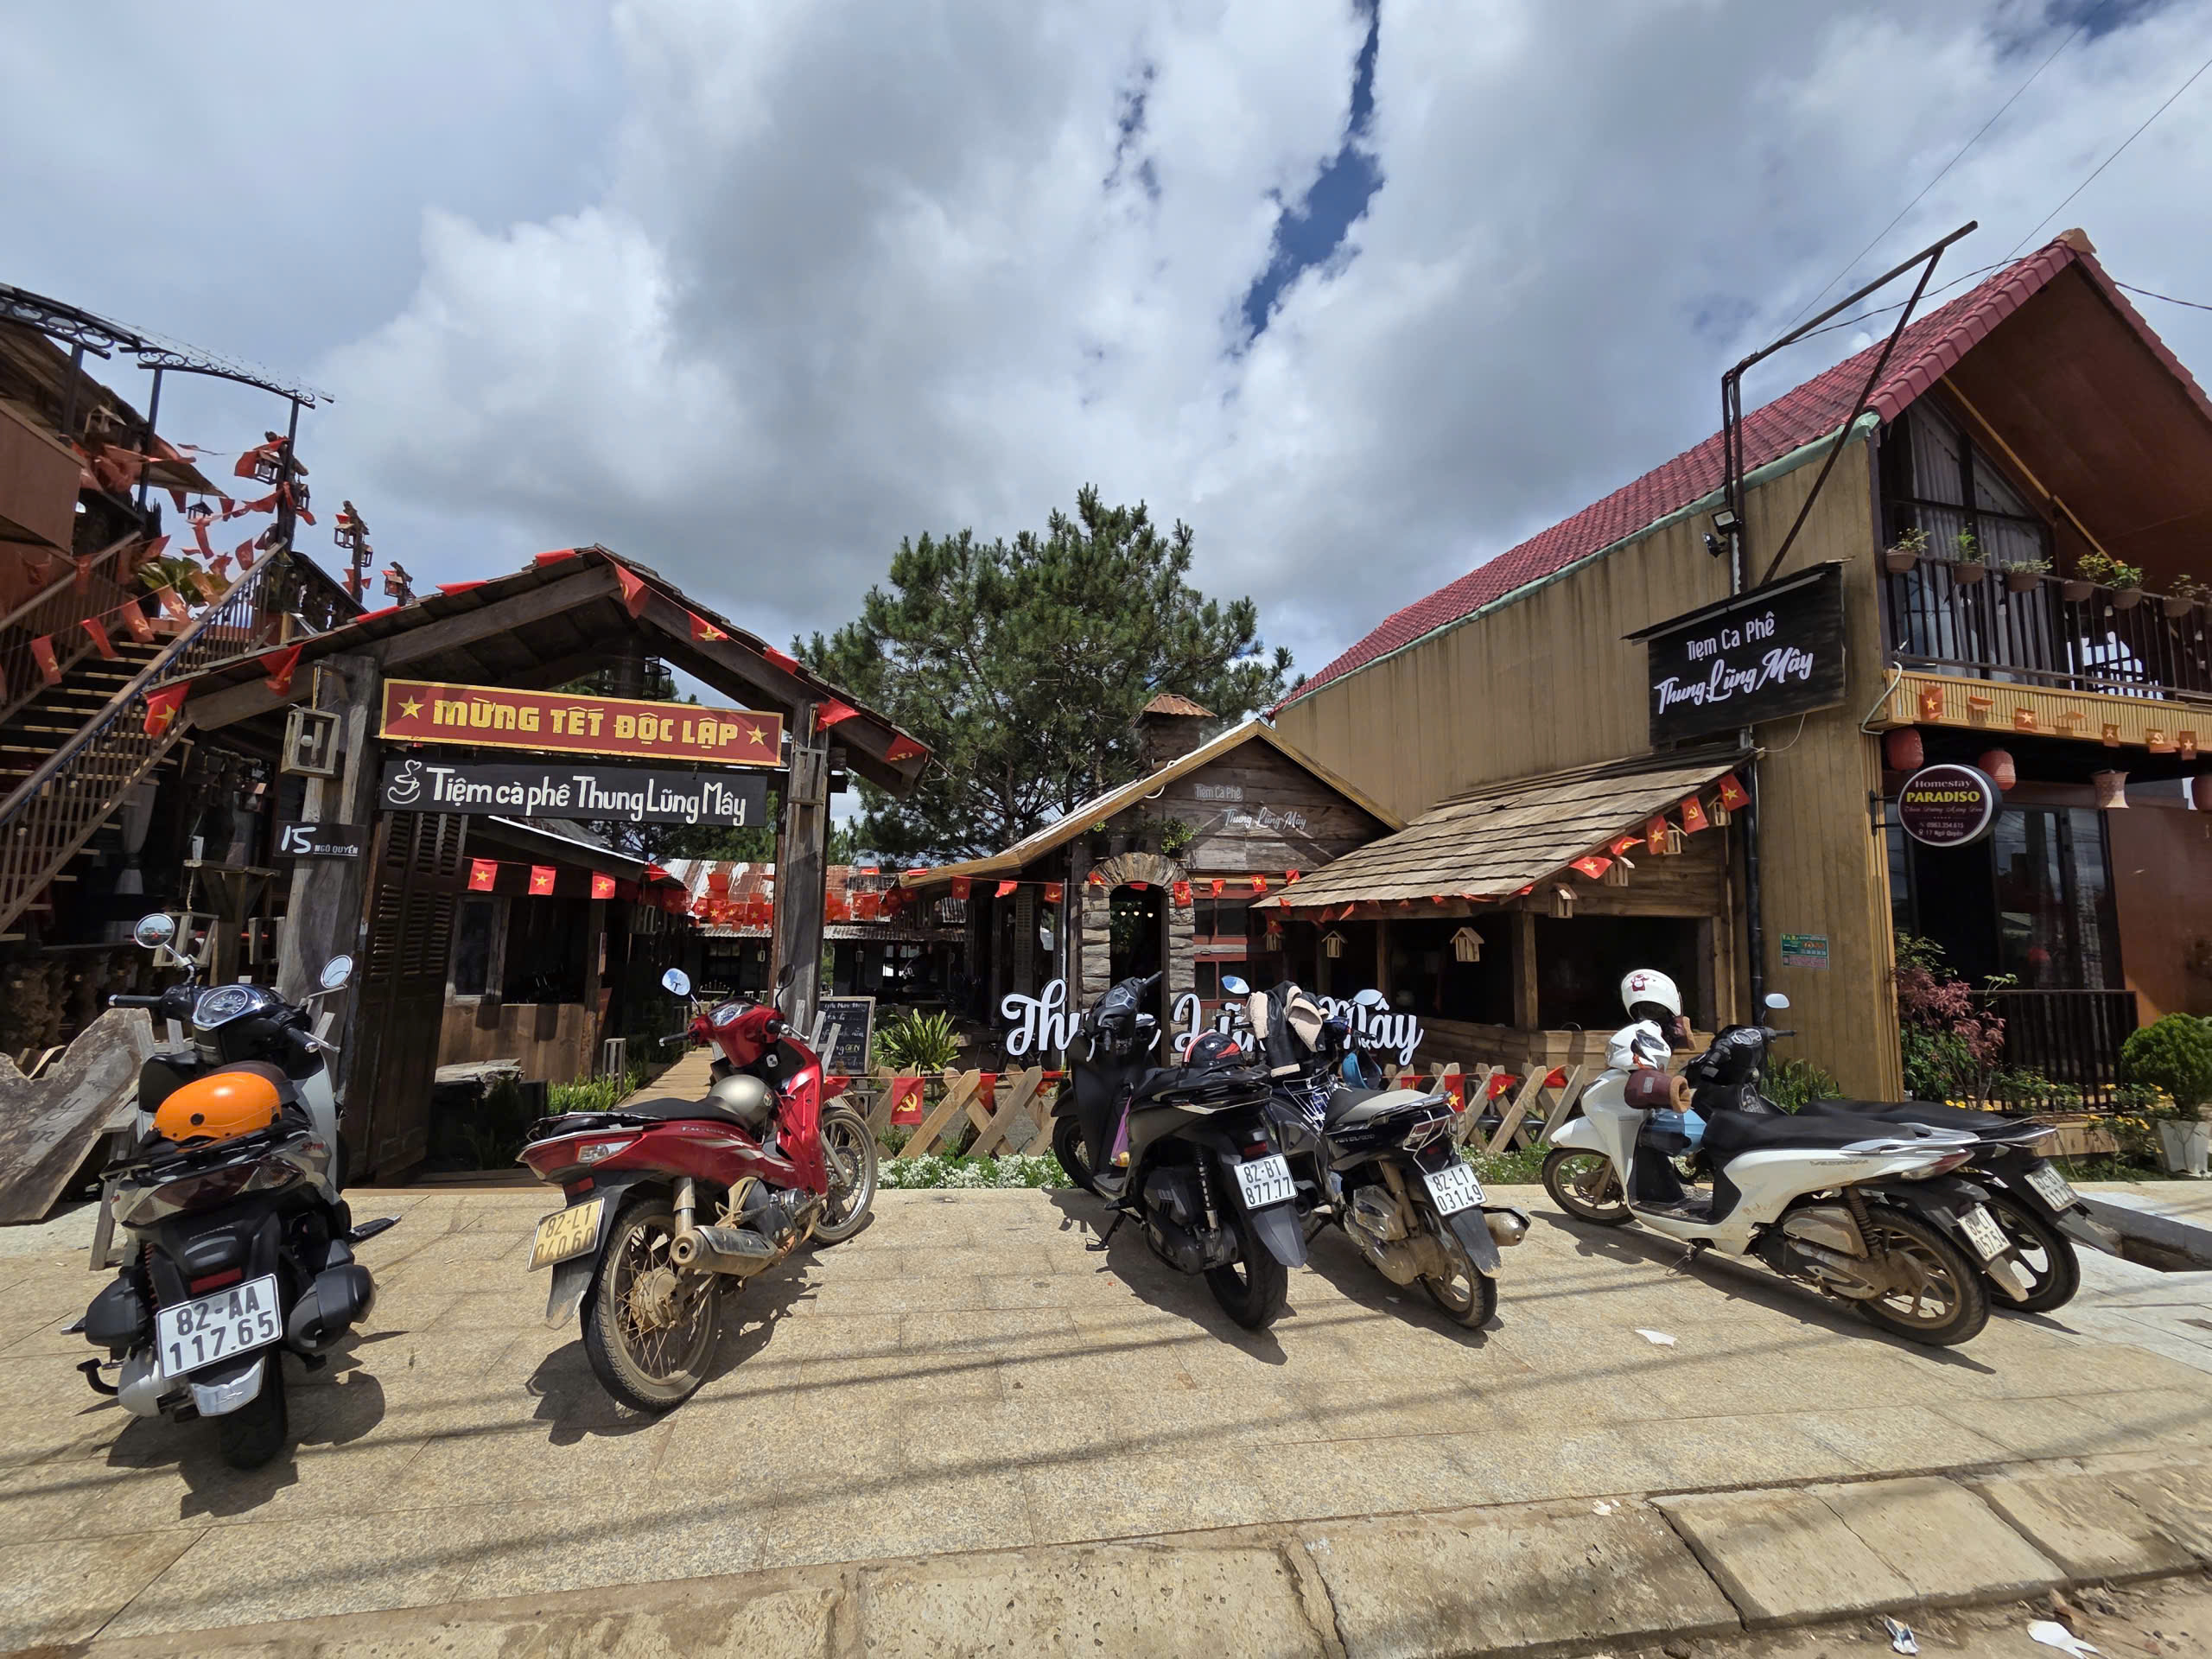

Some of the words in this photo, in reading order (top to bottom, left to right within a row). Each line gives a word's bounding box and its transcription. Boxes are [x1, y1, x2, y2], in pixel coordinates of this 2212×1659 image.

[1745, 610, 1775, 643] Phê
[1654, 677, 1706, 715] Thung
[1706, 659, 1757, 702] Lũng
[1756, 647, 1814, 690] Mây
[433, 697, 539, 732] MỪNG
[550, 706, 604, 736] TẾT
[613, 712, 674, 745] ĐỘC
[682, 717, 739, 749] LẬP
[426, 766, 493, 807] Tiệm
[495, 781, 524, 804] cà
[525, 776, 571, 817] phê
[573, 775, 644, 822] Thung
[647, 779, 699, 824] Lũng
[702, 782, 746, 827] Mây
[1906, 791, 1980, 803] PARADISO
[1283, 811, 1306, 830] Mây
[281, 825, 317, 854] 15
[1244, 1159, 1281, 1183] 82-B1
[1433, 1167, 1469, 1192] 82-L1
[1246, 1177, 1290, 1205] 877.77
[1437, 1185, 1483, 1211] 031.49
[546, 1205, 591, 1238] 82-L1
[176, 1286, 259, 1336] 82-AA
[169, 1311, 274, 1370] 117.65
